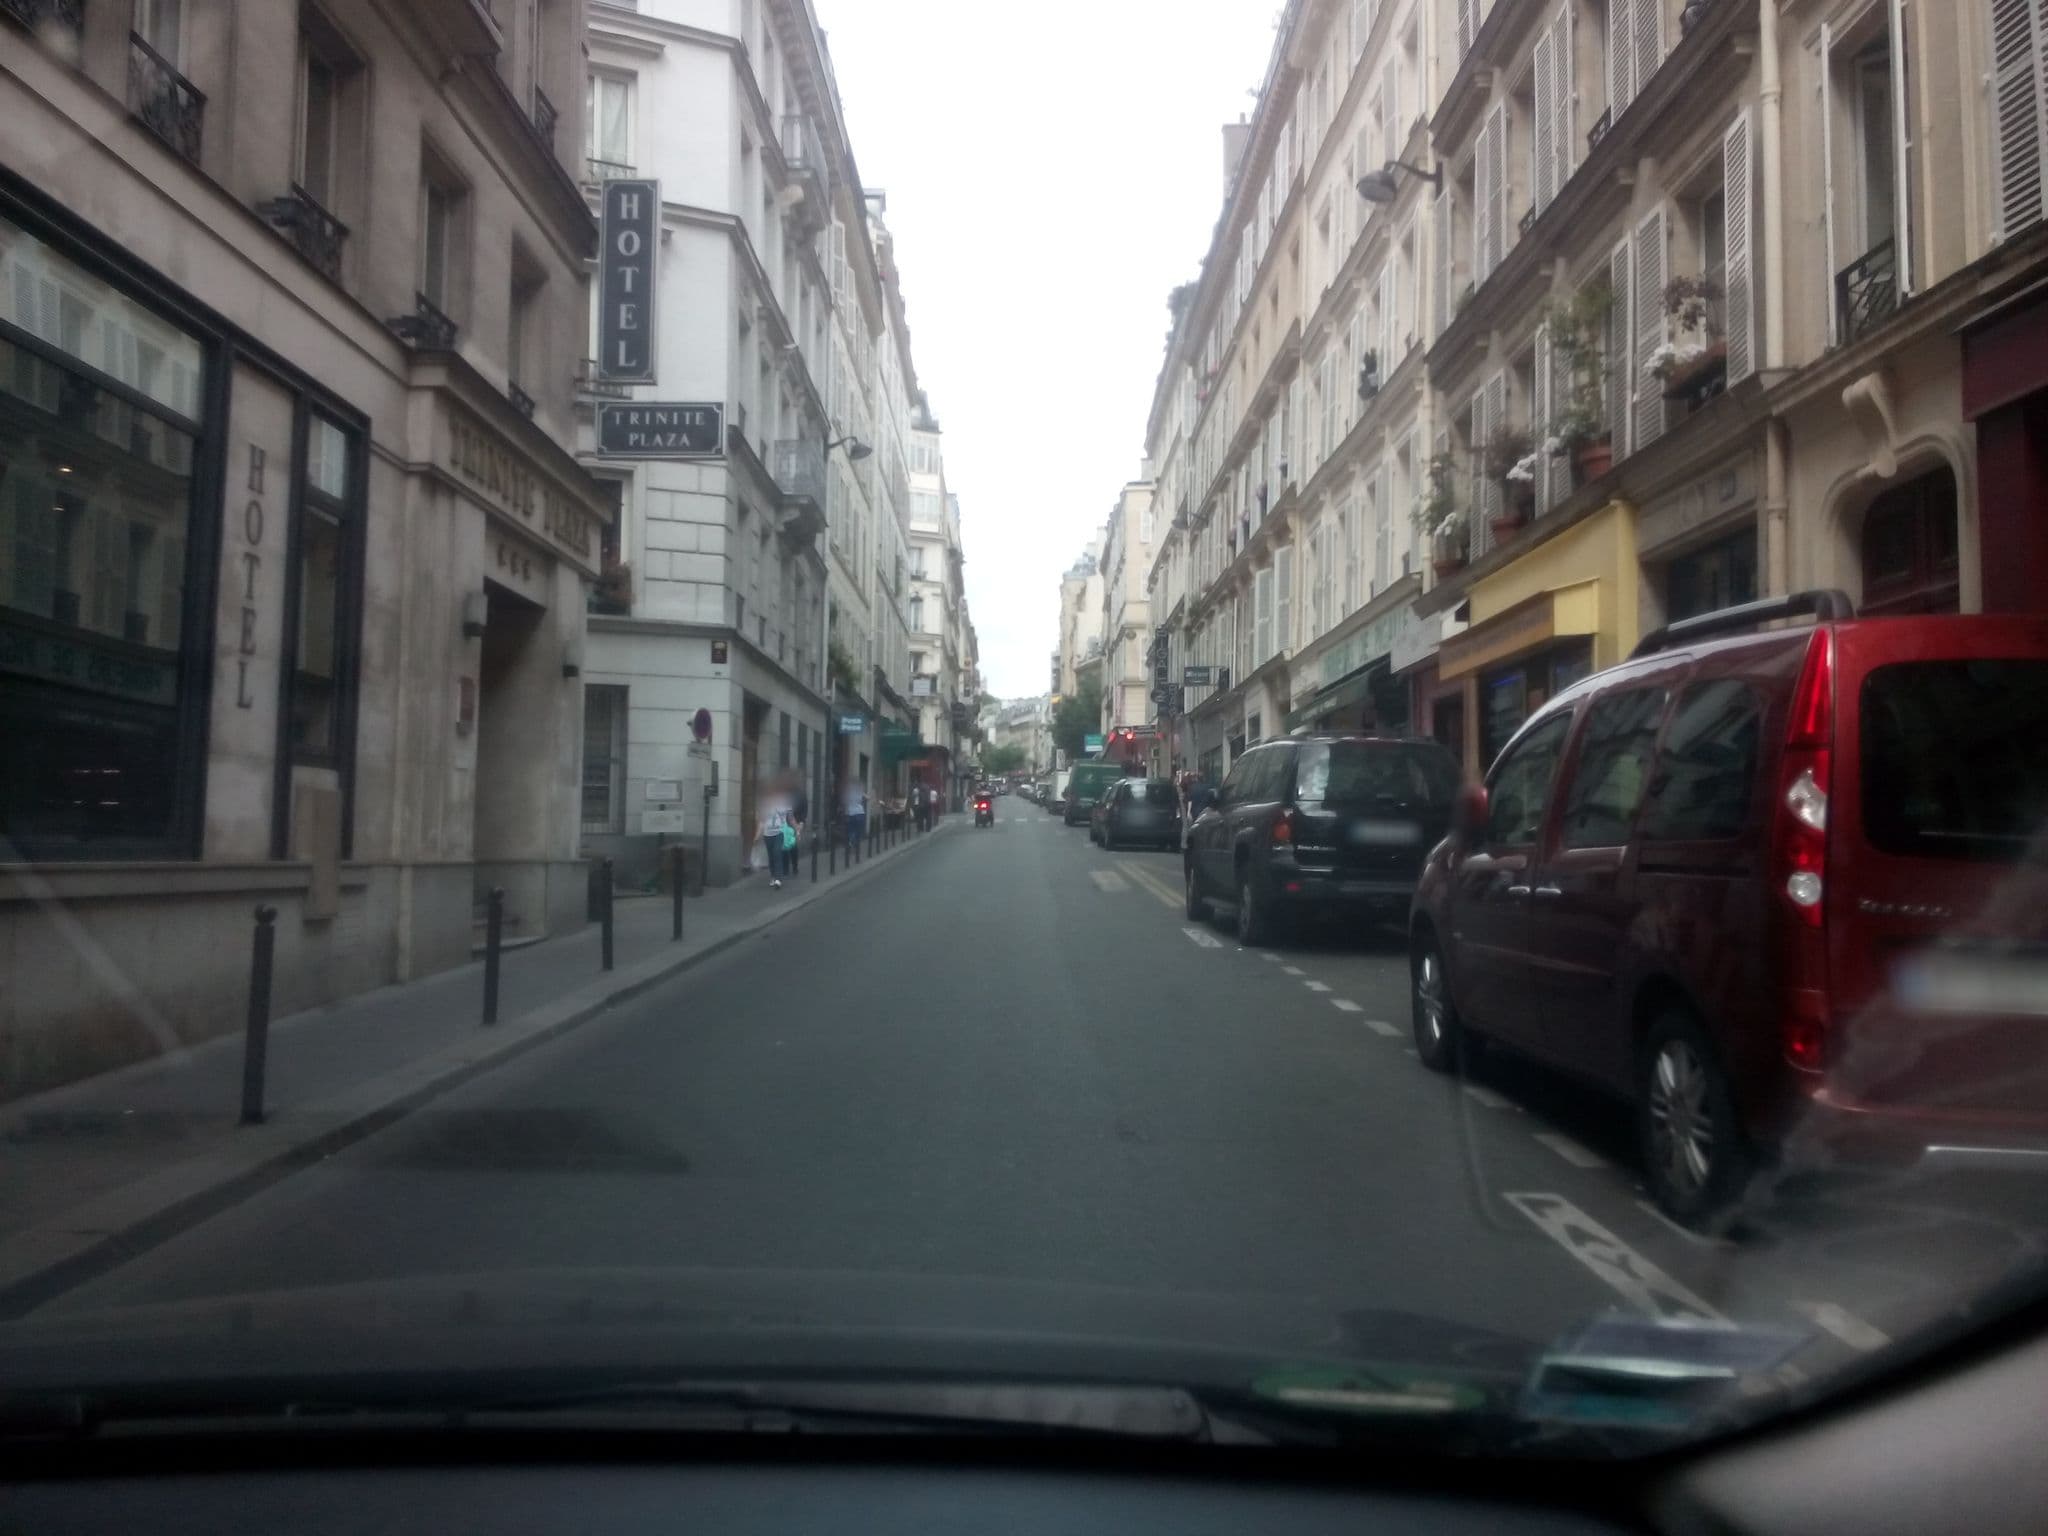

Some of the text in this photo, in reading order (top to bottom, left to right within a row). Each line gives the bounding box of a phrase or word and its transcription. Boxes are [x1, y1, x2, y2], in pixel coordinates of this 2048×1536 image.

[617, 192, 641, 368] HOTEL
[614, 411, 705, 426] TRINITE
[628, 432, 691, 447] PLAZA
[237, 442, 267, 709] HOTEL
